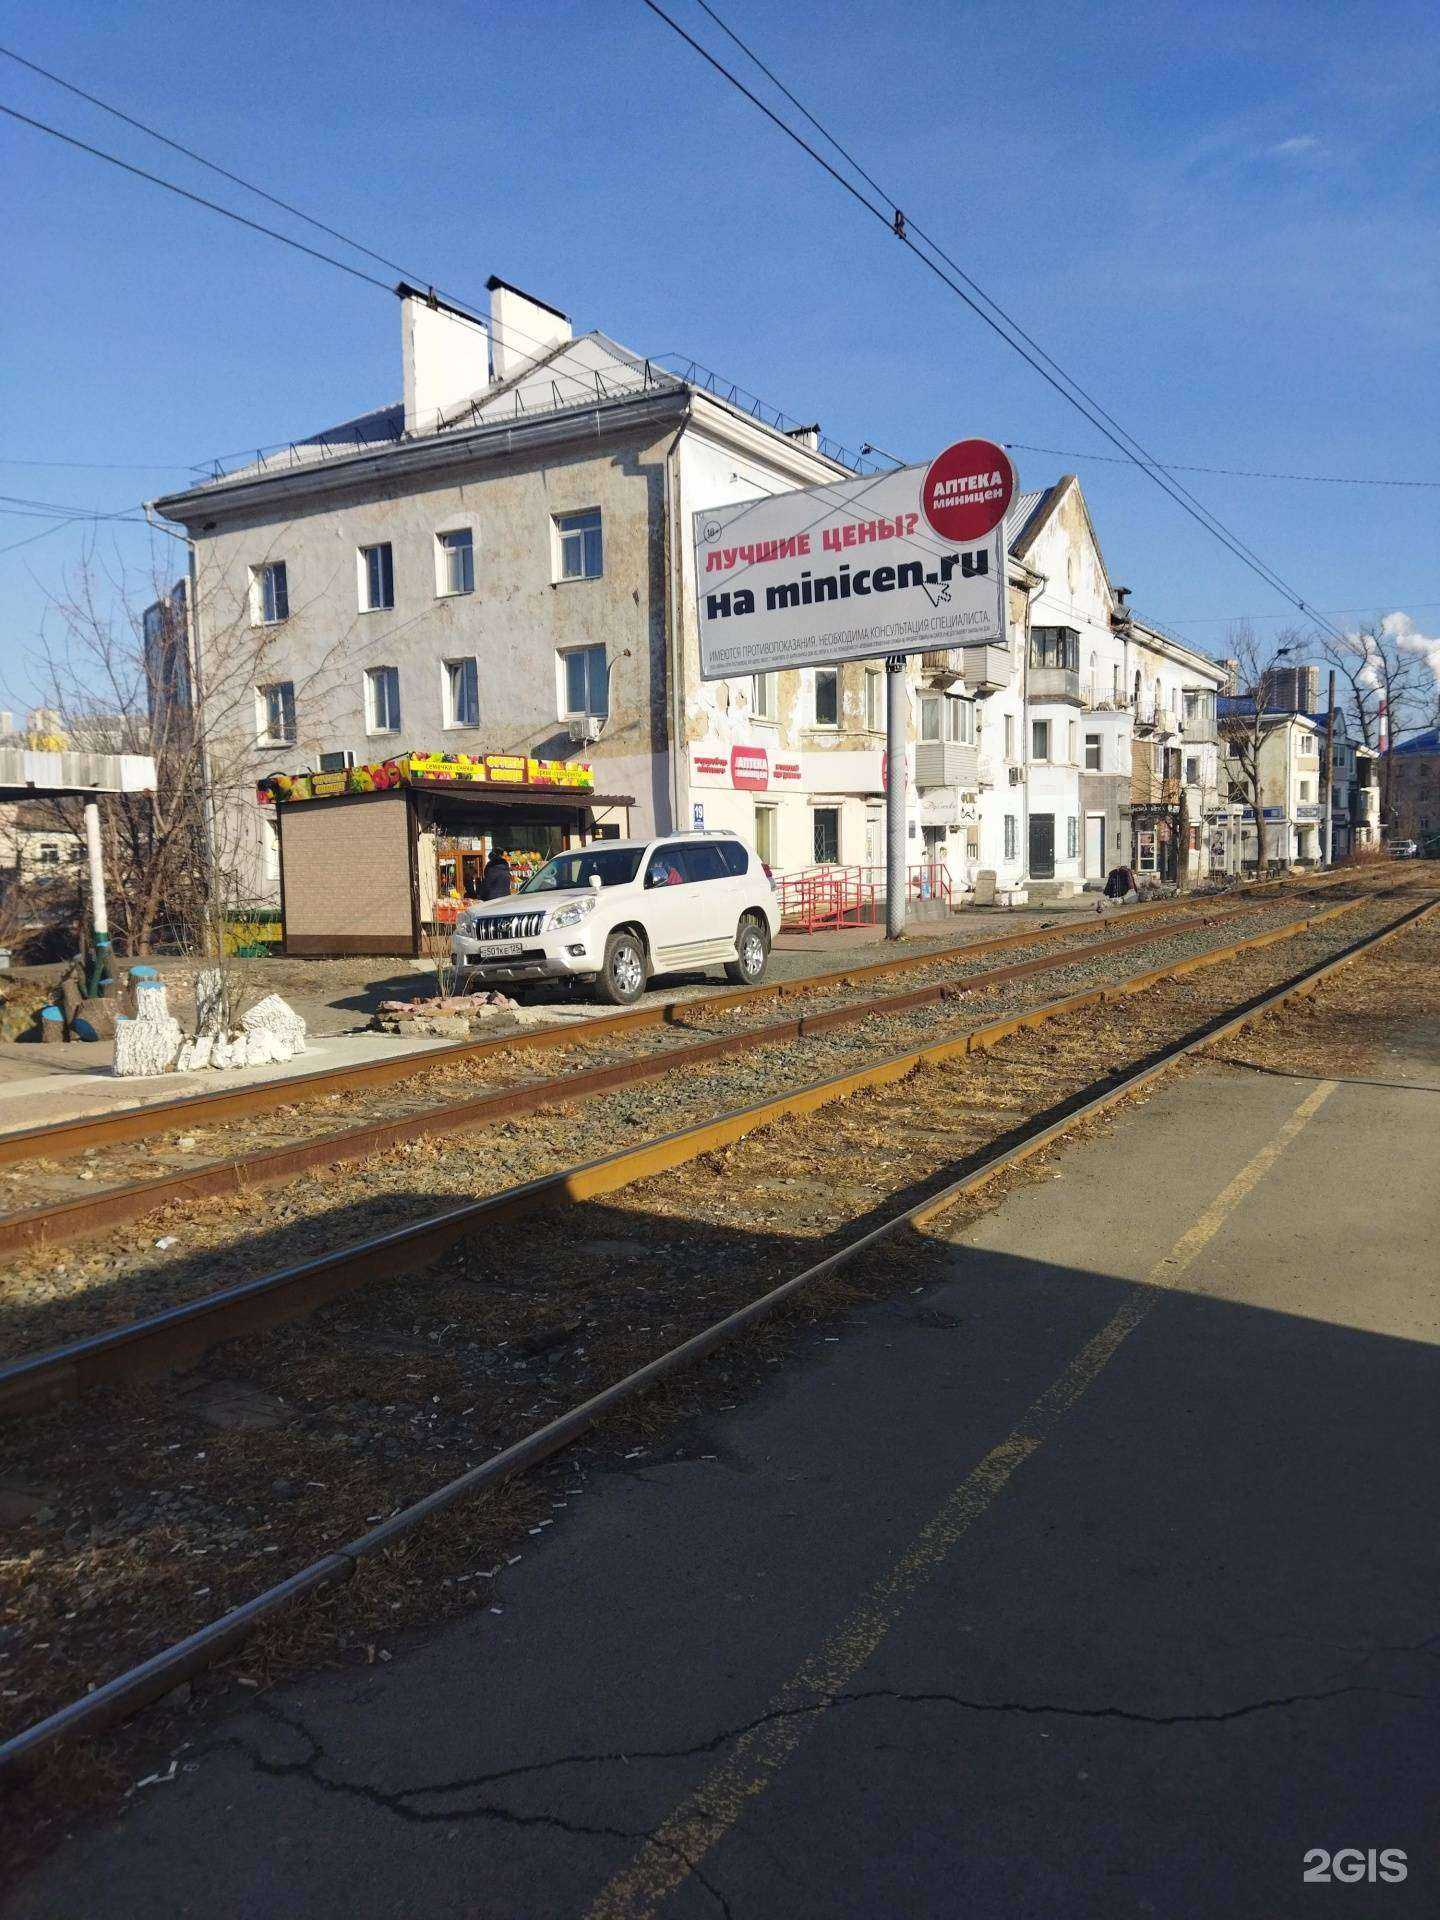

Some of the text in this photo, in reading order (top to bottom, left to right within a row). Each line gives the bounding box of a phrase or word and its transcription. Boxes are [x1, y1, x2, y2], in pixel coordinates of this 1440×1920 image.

[933, 470, 1002, 497] АПТЕКА
[705, 512, 919, 572] ЛУЧШИЕ ЦЕНЫ?
[707, 549, 988, 620] на minicen.ru
[709, 645, 741, 661] ИМЕЮТСЯ
[819, 627, 869, 646] НЕОБХОДИМА
[870, 618, 929, 637] КОНСУЛЬТАЦИЯ
